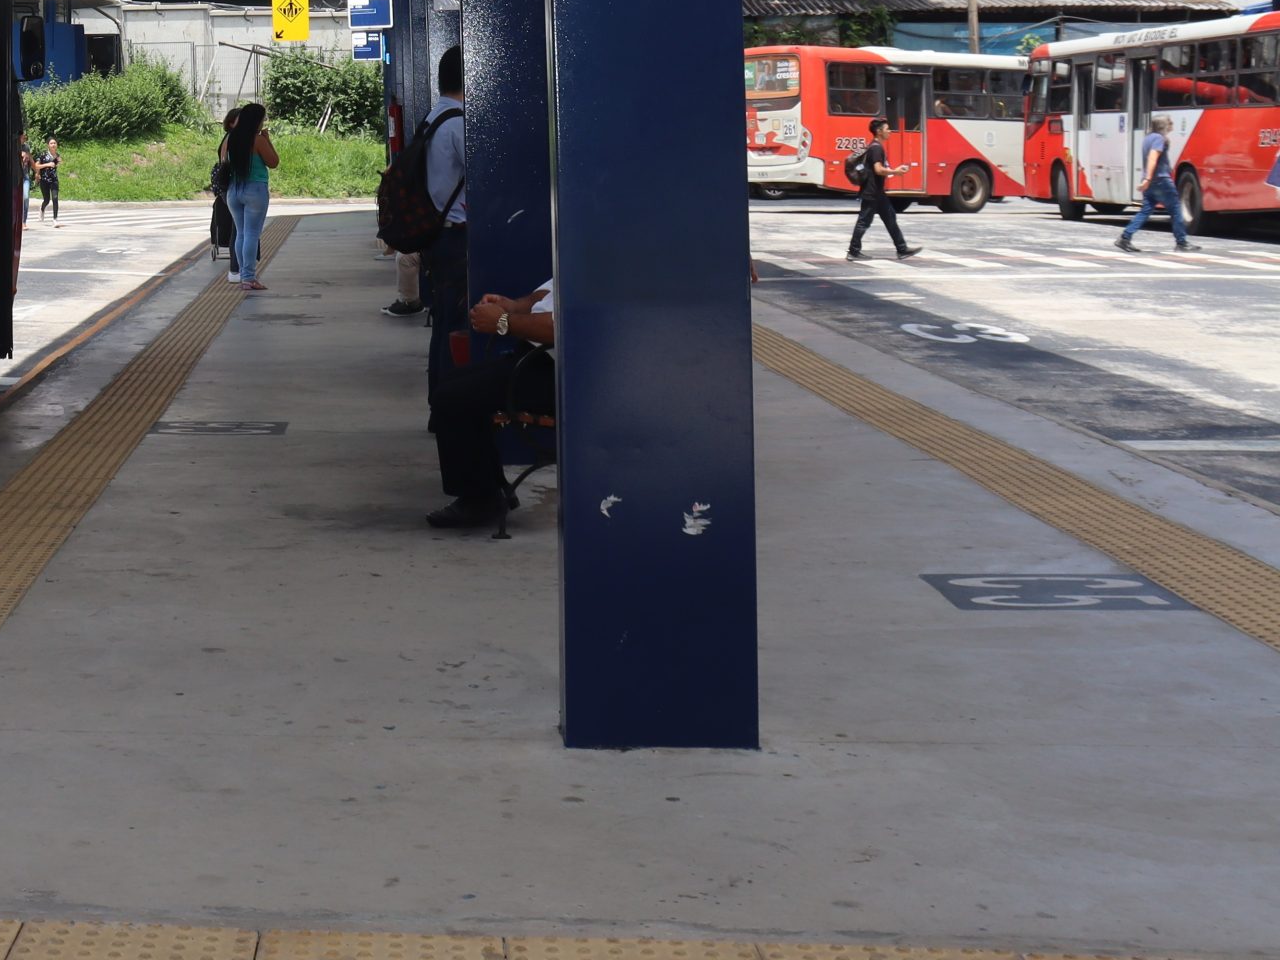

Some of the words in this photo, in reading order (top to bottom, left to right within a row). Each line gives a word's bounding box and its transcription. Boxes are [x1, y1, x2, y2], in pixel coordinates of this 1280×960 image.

[784, 124, 796, 136] 261
[836, 137, 866, 150] 2285
[901, 322, 1031, 344] C3
